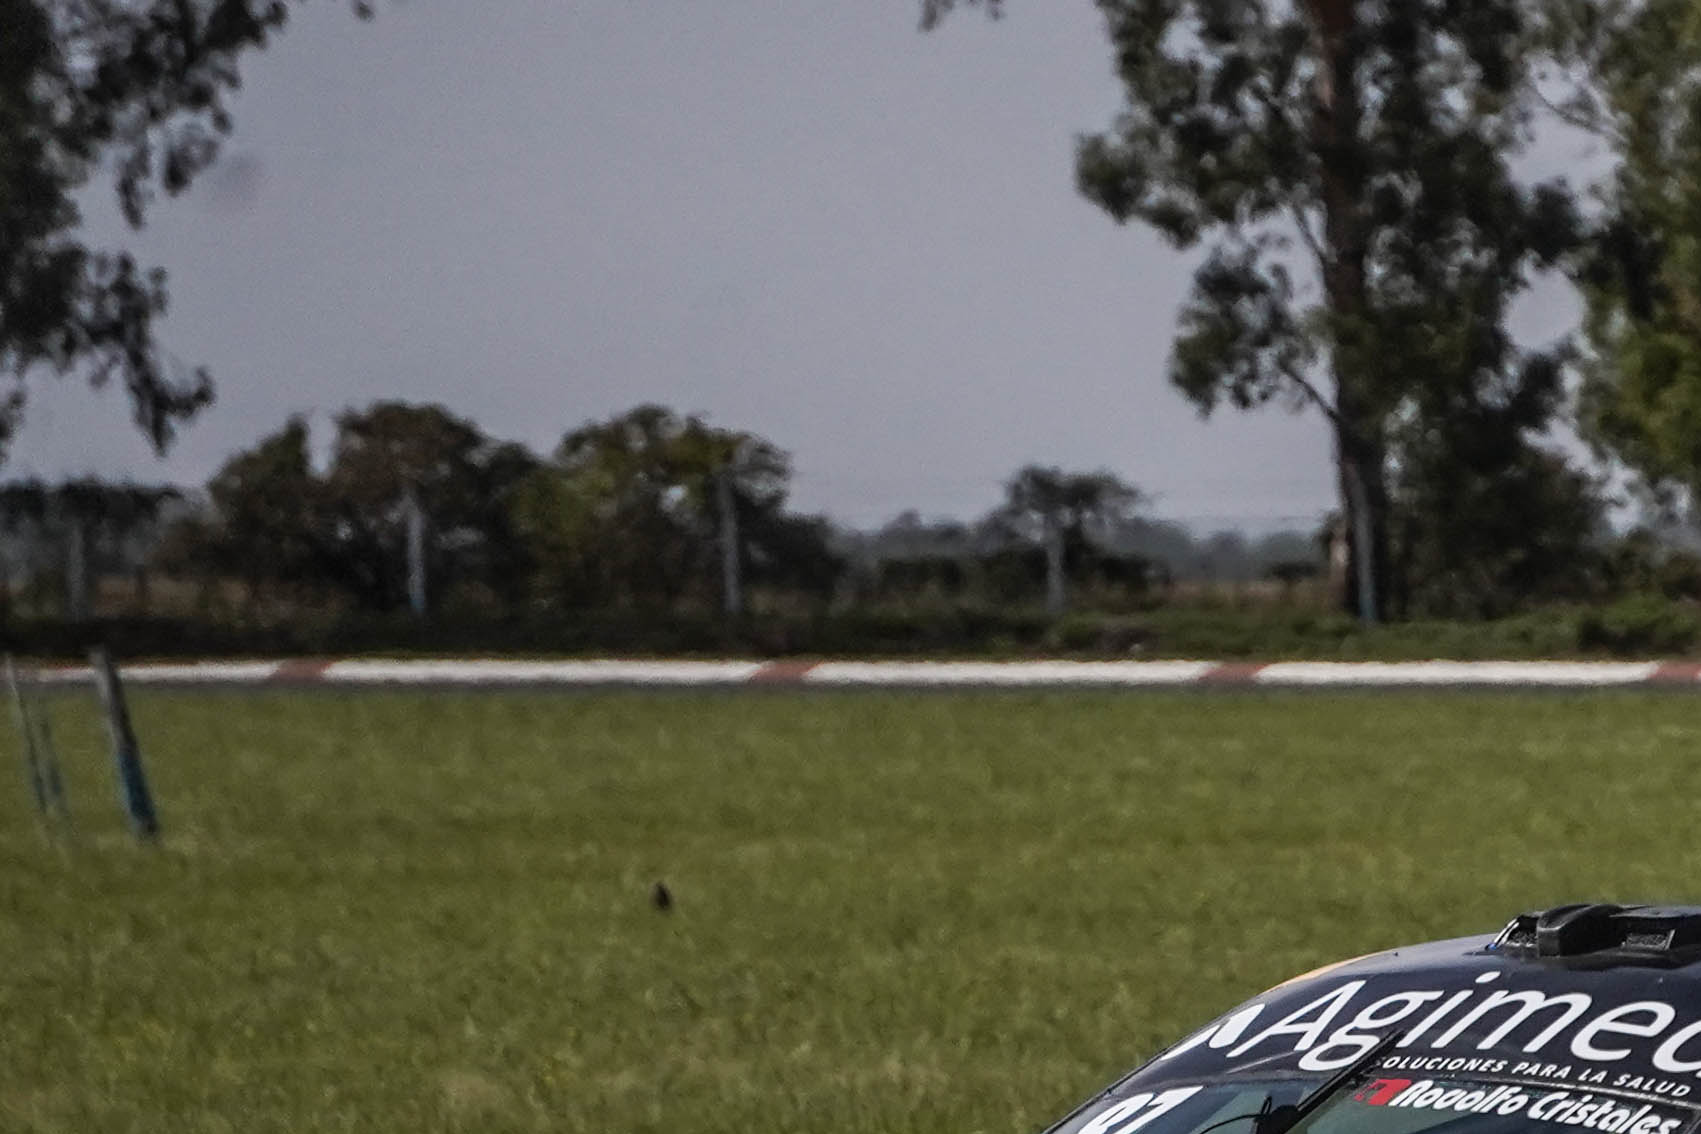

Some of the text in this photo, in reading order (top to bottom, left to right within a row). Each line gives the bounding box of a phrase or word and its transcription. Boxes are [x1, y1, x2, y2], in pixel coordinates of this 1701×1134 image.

[1376, 1055, 1692, 1099] OLUCIONES PARA LA SALUD
